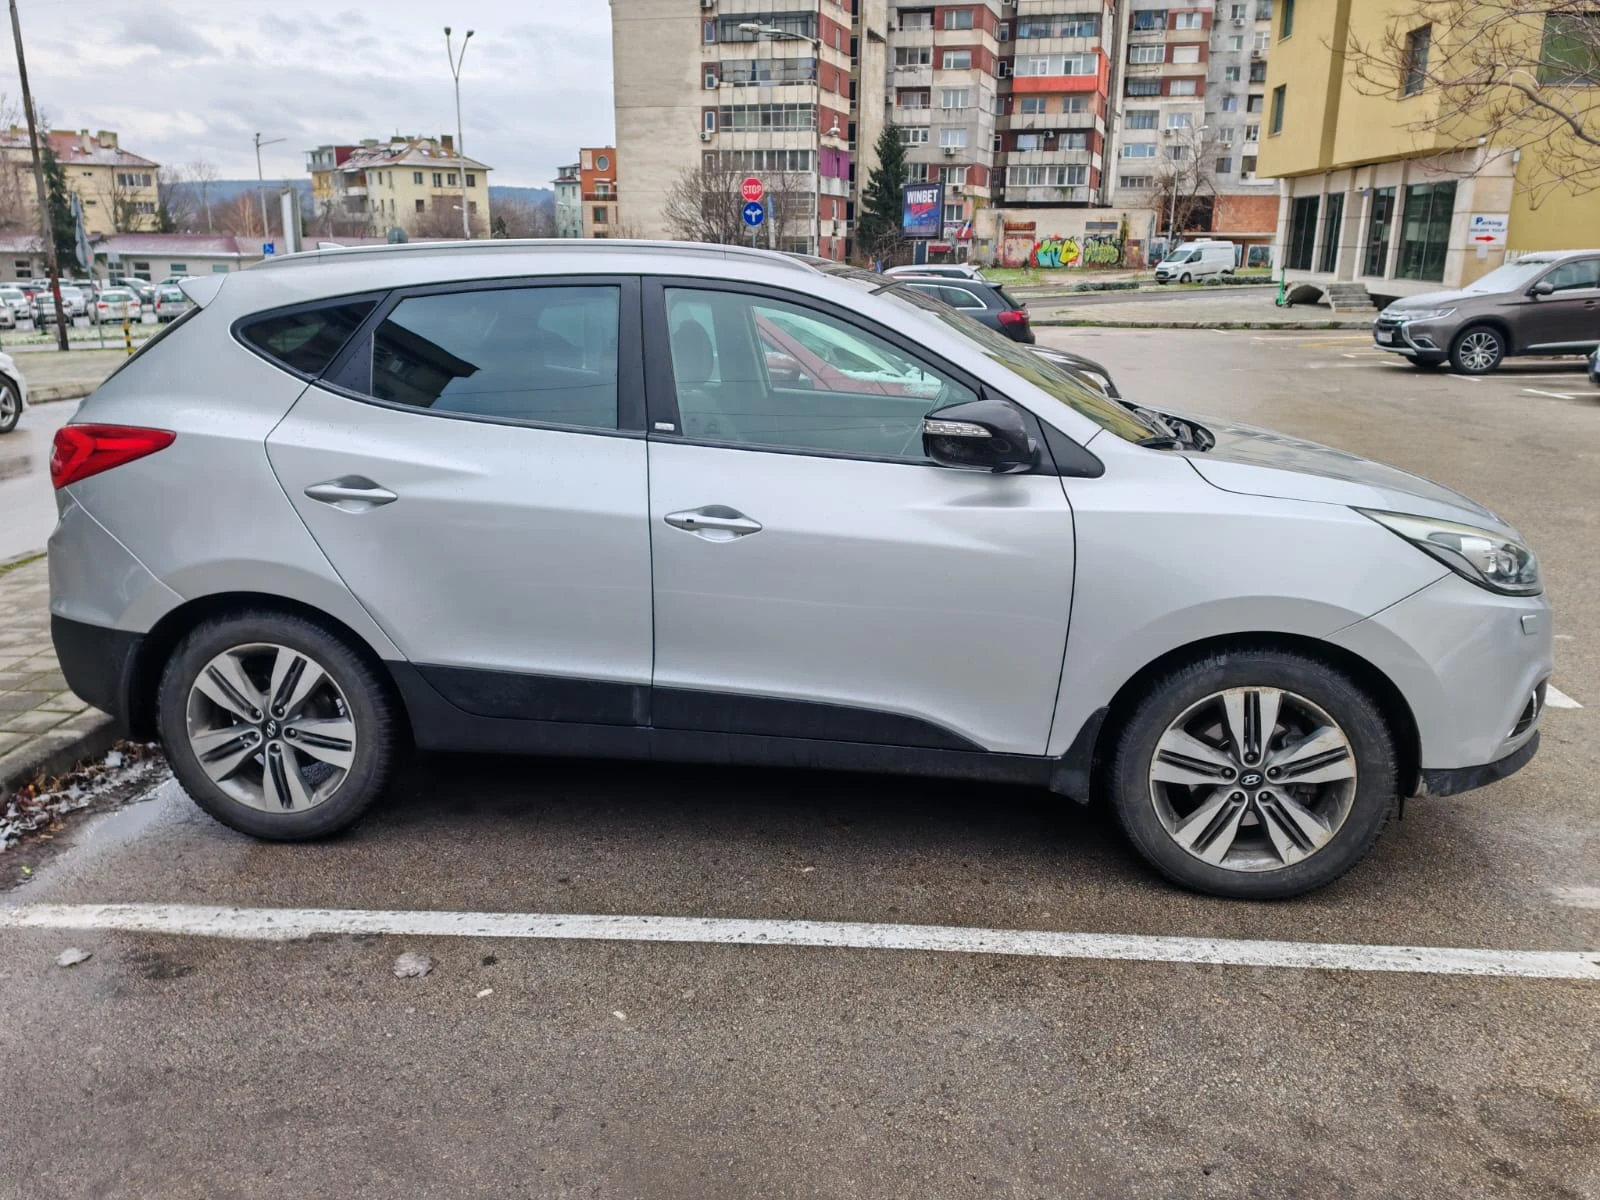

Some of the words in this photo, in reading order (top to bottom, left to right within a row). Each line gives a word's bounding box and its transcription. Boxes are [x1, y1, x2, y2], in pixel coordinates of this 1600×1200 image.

[744, 185, 762, 195] STOP
[907, 189, 938, 205] WINBET
[1475, 216, 1502, 228] Parking
